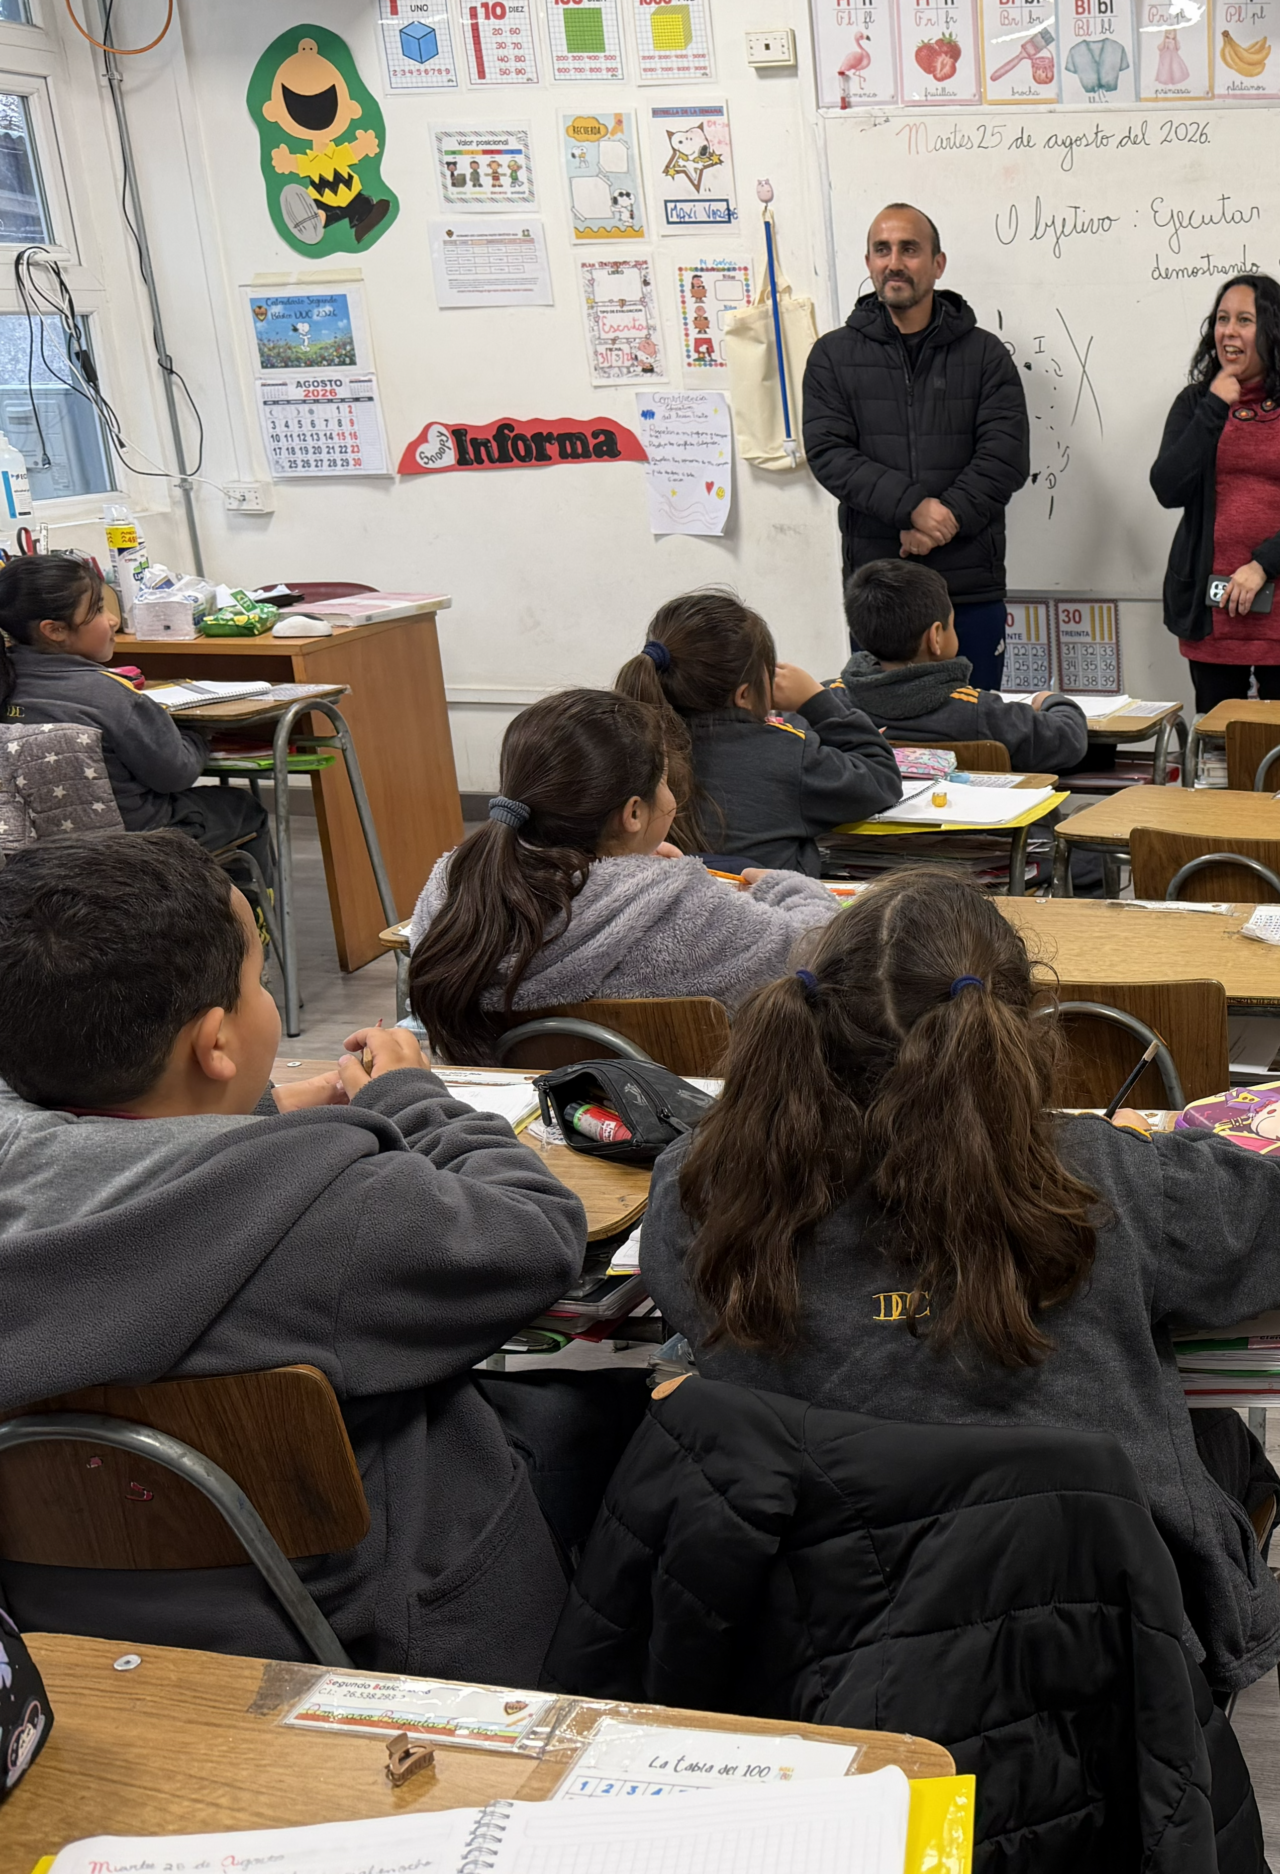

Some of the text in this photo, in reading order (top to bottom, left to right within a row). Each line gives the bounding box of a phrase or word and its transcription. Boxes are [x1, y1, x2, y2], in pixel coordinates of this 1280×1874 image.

[410, 4, 428, 12] UNO
[481, 2, 506, 21] 10
[1000, 10, 1020, 26] Br
[1225, 5, 1266, 25] Pl pl
[1074, 18, 1114, 37] Bl bl
[924, 87, 957, 101] frutillas
[1011, 86, 1040, 96] brocha
[1154, 87, 1191, 98] princesa
[573, 126, 602, 135] RECUERDA
[476, 139, 509, 147] posicional
[896, 121, 976, 155] Martes
[1008, 128, 1037, 151] de
[1043, 123, 1115, 172] agosto
[1116, 120, 1151, 149] del
[1151, 193, 1261, 254] Ejecutar
[306, 296, 337, 307] Segundo
[601, 316, 648, 334] Escrita
[296, 380, 342, 388] AGOSTO
[303, 389, 337, 398] 2026
[271, 432, 358, 443] 10 11 12 13 14 15 16
[419, 430, 452, 465] Snoopy
[452, 423, 621, 466] Informa
[273, 446, 360, 456] 17 18 19 20 21 22 23
[288, 457, 362, 469] 25 26 27 28 29 30
[1062, 609, 1082, 624] 30
[1013, 646, 1046, 657] 22 23
[1064, 645, 1115, 656] 31 32 33
[1015, 661, 1029, 672] 25
[1064, 660, 1115, 671] 34 35 36
[1015, 676, 1047, 687] 28 29
[1065, 675, 1115, 686] 37 38 39
[325, 1678, 371, 1690] Segundo
[648, 1756, 771, 1778] La tabla del 100
[580, 1780, 640, 1795] 1 2 3
